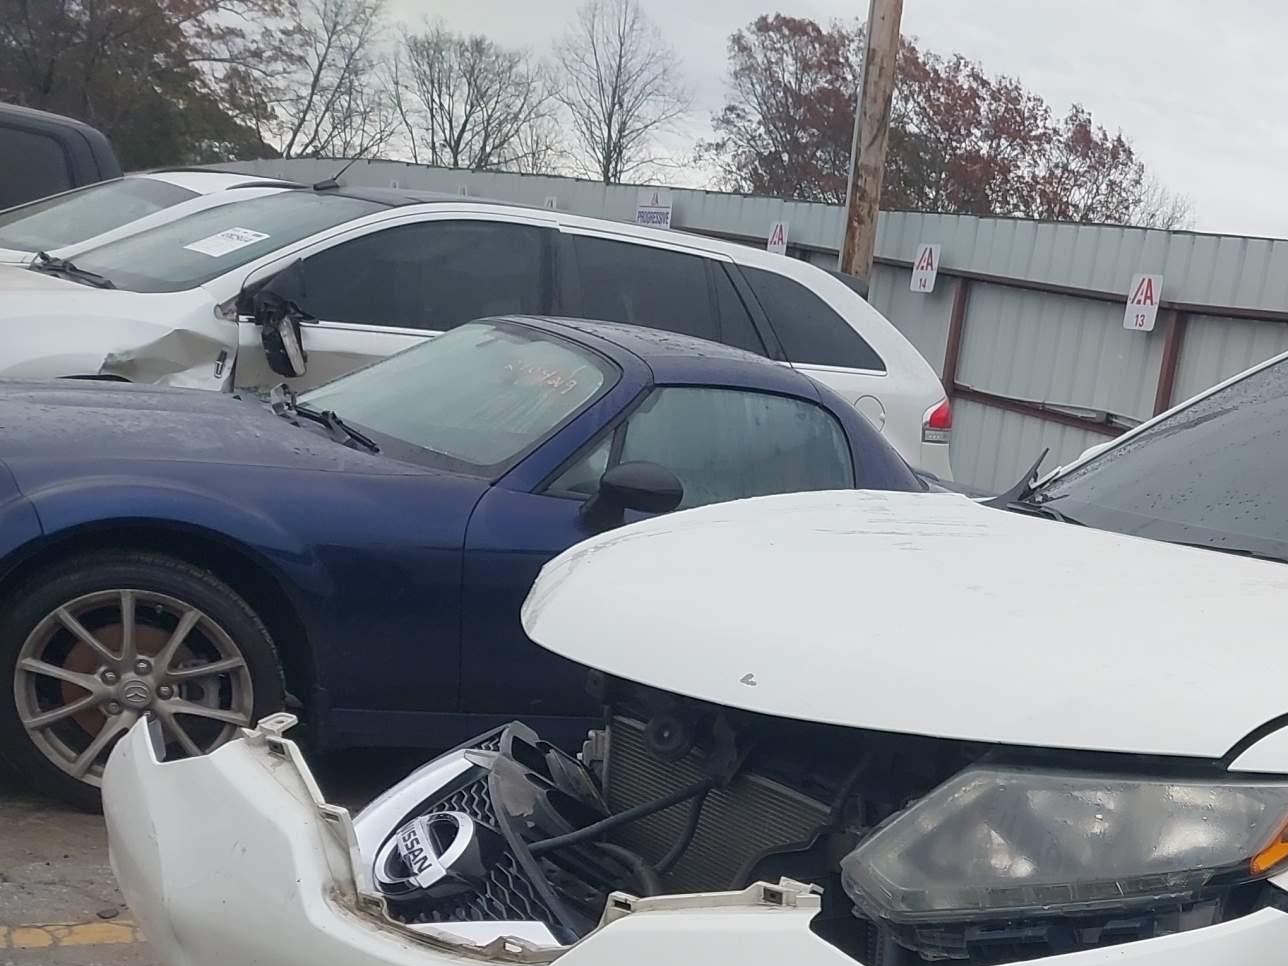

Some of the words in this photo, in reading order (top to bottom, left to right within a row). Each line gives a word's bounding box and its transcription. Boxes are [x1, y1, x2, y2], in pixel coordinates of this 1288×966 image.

[919, 278, 928, 289] 14
[1135, 313, 1146, 328] 13
[398, 820, 433, 874] NISSAN
